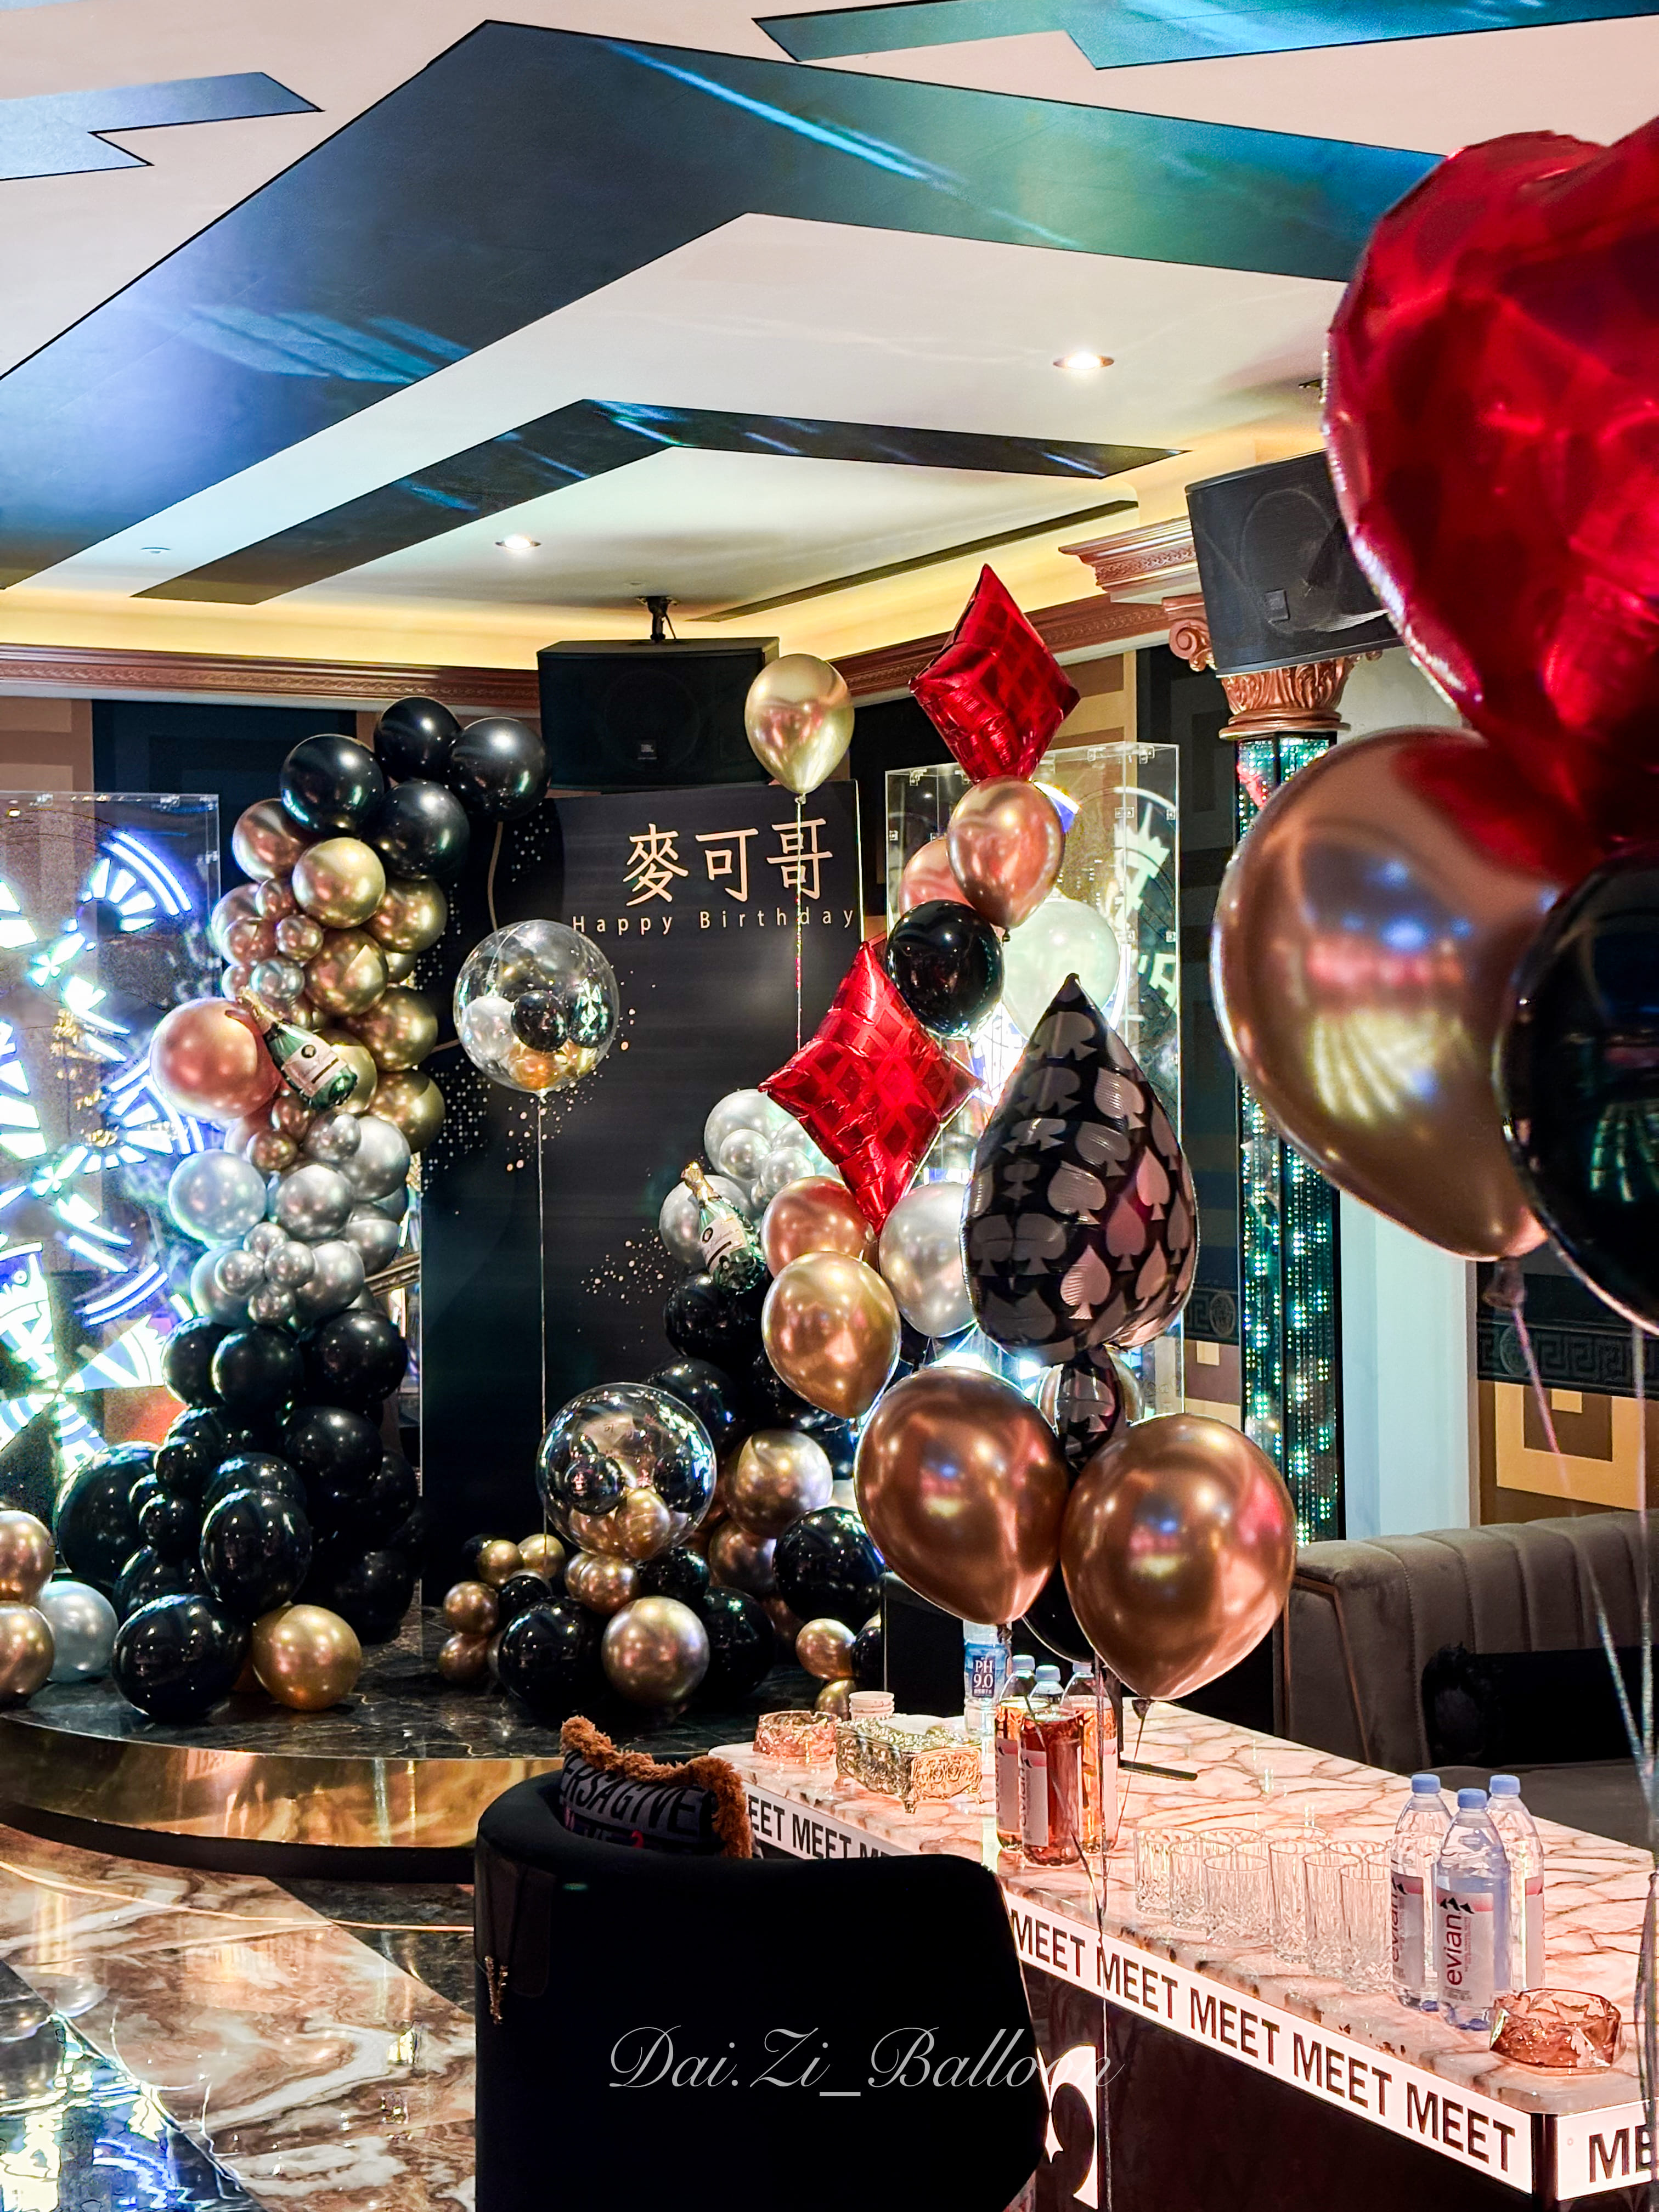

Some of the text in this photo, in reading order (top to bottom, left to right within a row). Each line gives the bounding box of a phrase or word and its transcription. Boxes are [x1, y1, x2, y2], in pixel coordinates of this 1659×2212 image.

[623, 818, 833, 907] 麥可哥
[573, 907, 854, 935] Happy Birthday
[973, 1673, 994, 1688] 9.0
[975, 1660, 994, 1673] PH
[748, 1794, 785, 1841] EET
[1444, 1914, 1463, 1985] evian
[1011, 1908, 1516, 2172] MEET MEET MEET MEET MEET
